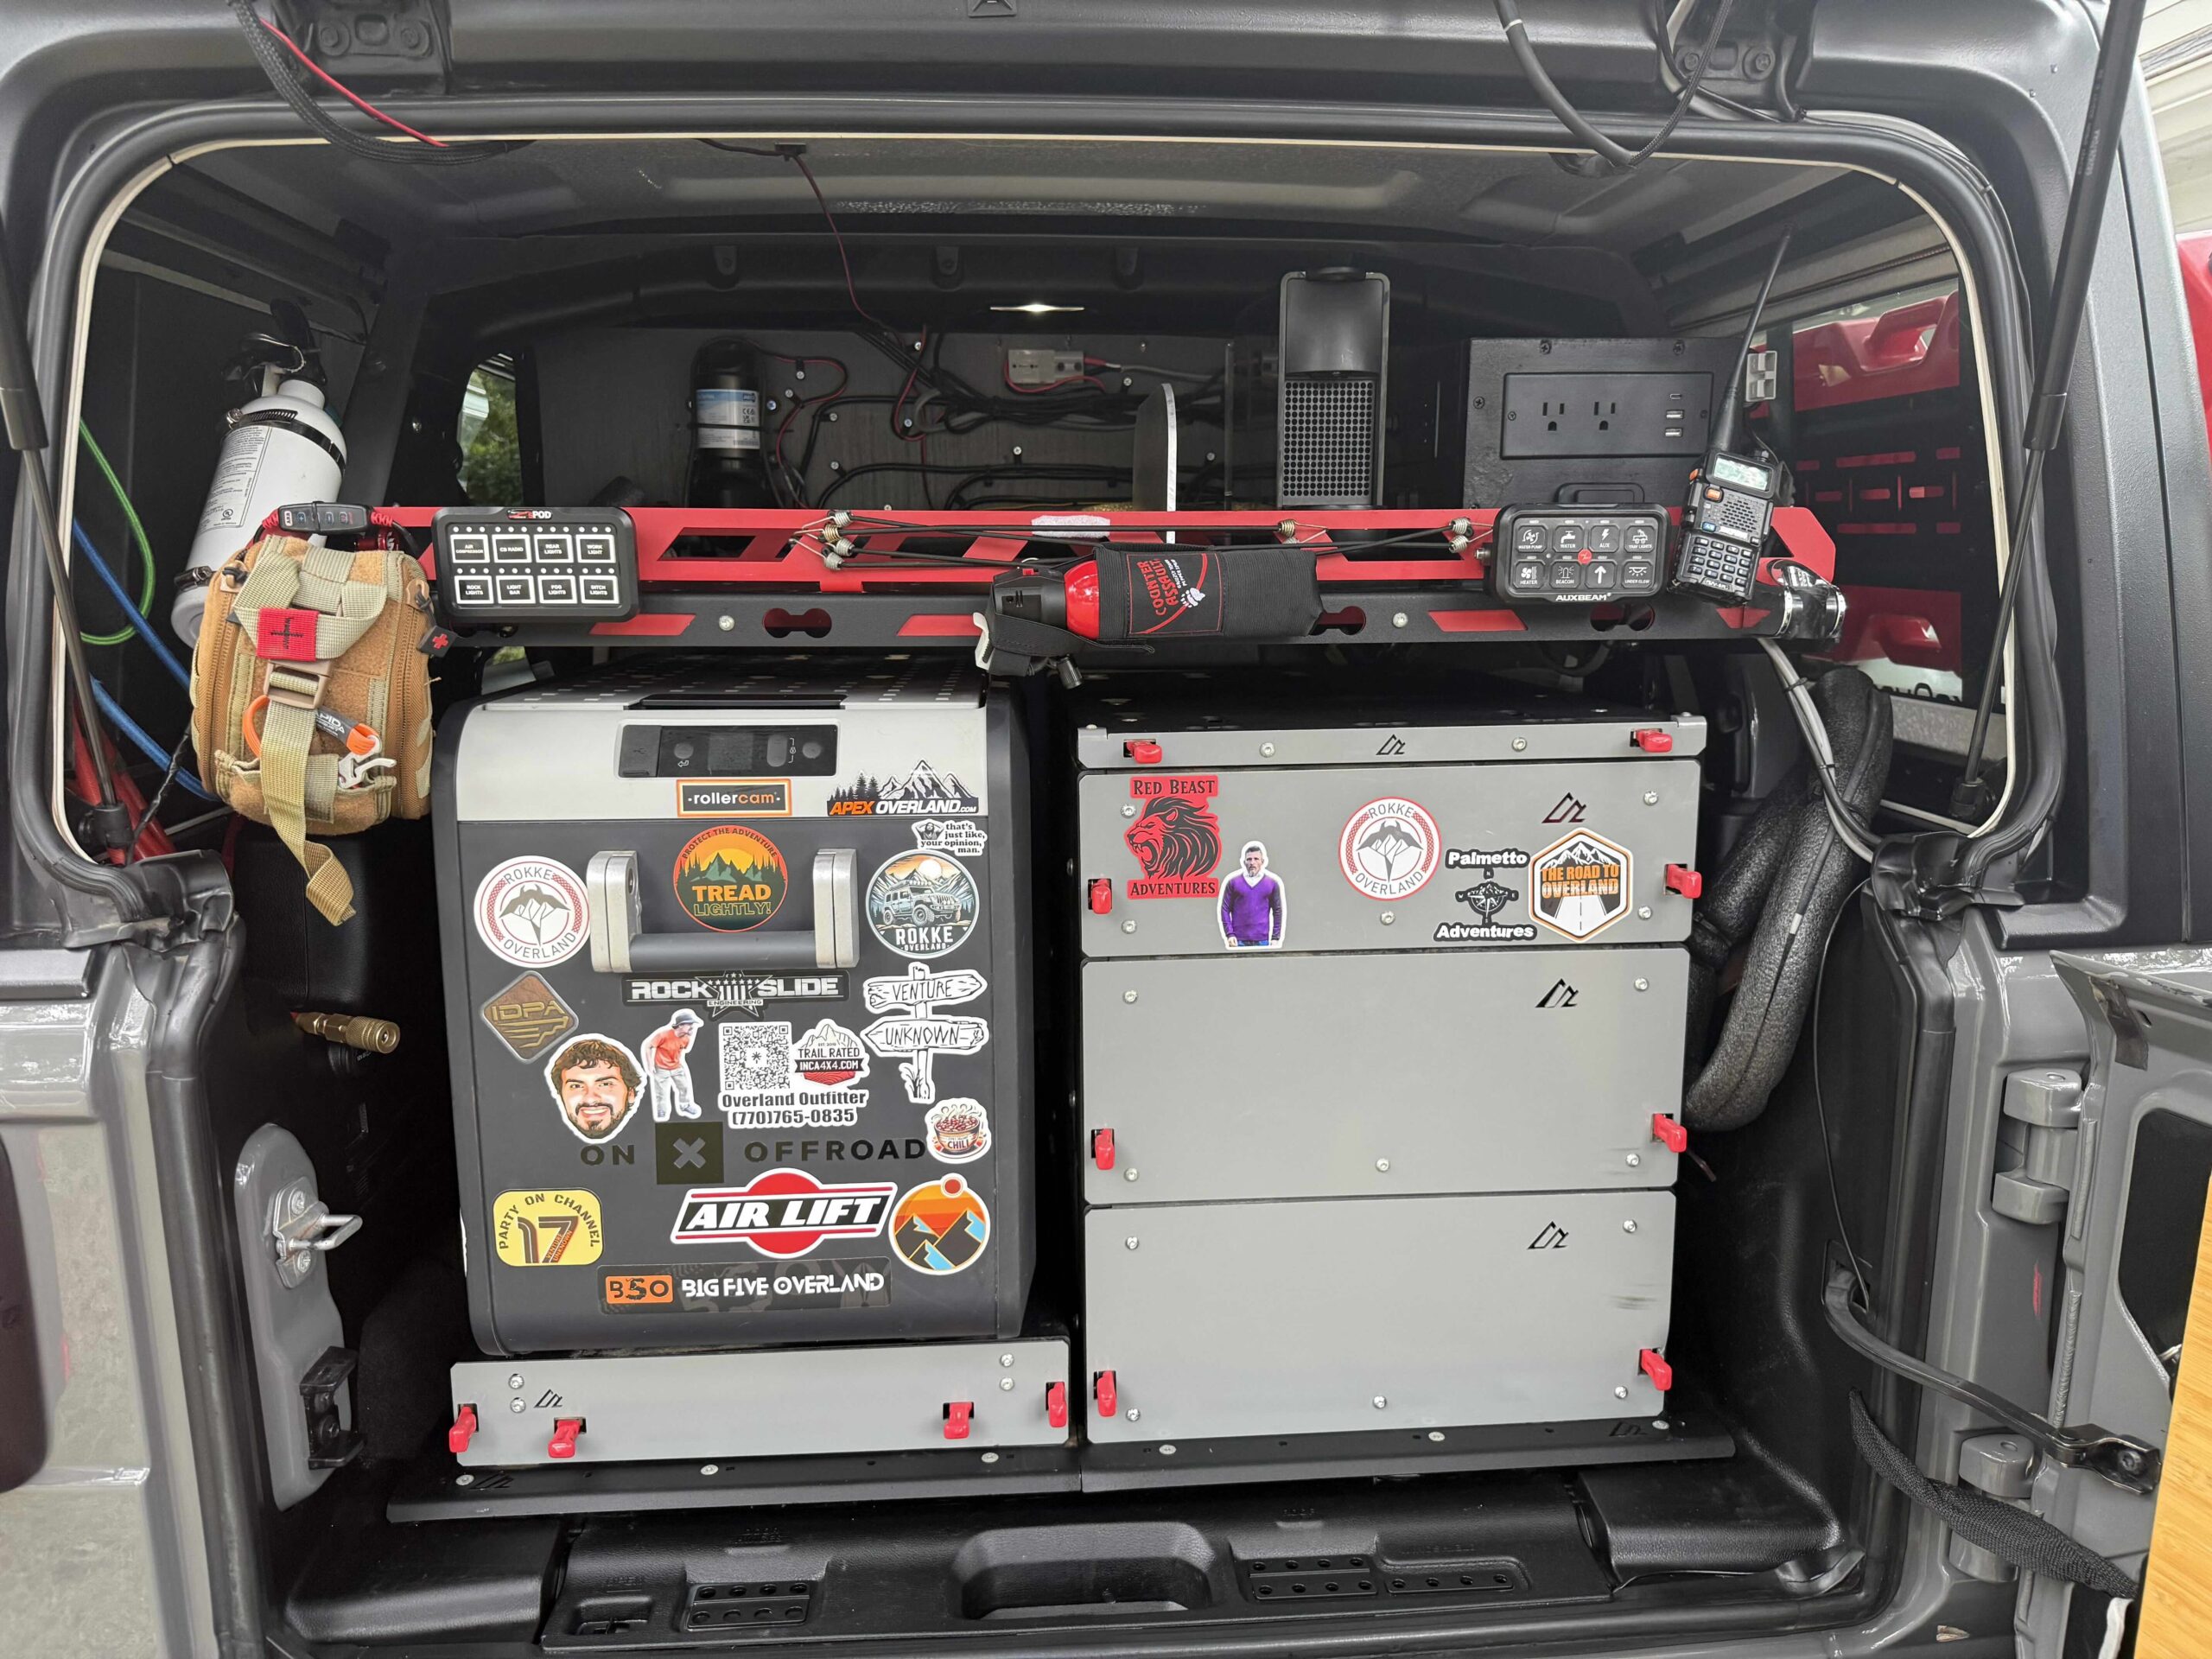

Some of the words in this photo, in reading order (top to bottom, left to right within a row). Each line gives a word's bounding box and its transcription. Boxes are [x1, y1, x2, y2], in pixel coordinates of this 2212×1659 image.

[1136, 560, 1168, 616] COUNTER
[1149, 558, 1179, 606] ASSAULT
[1134, 779, 1163, 795] RED
[1170, 779, 1216, 794] BEAST
[694, 791, 777, 804] rollercam
[830, 800, 875, 816] APEX
[1368, 803, 1414, 819] ROKKE
[683, 832, 715, 859] PROTECT
[713, 827, 730, 836] THE
[732, 828, 778, 858] ADVENTURE
[944, 839, 982, 848] opinion,
[1448, 851, 1528, 865] Palmetto
[503, 867, 554, 884] ROKKE
[1541, 868, 1563, 881] THE
[1567, 865, 1600, 880] ROAD
[1603, 864, 1619, 878] TO
[1130, 882, 1216, 896] ADVENTURES
[1355, 871, 1423, 895] OVERLAND
[1541, 879, 1619, 899] OVERLAND
[691, 884, 772, 902] TREAD
[694, 902, 772, 917] LIGHTLY!
[895, 926, 953, 944] ROKKE
[1436, 925, 1534, 938] Adventures
[503, 932, 576, 959] OVERLAND
[904, 943, 947, 951] OVERLAND
[632, 981, 715, 1000] ROCK
[757, 977, 839, 996] SLIDE
[893, 979, 954, 1001] VENTURE
[492, 1000, 566, 1021] IDPA
[886, 1025, 960, 1046] UNKNOWN
[798, 1048, 828, 1058] TRAIL
[829, 1047, 860, 1058] RATED
[800, 1060, 859, 1071] INCA4X4.COM
[722, 1093, 795, 1108] Overland
[799, 1091, 867, 1105] Outfitter
[733, 1109, 855, 1125] (770)765-0835
[581, 1145, 635, 1166] ON
[744, 1139, 926, 1163] OFFROAD
[499, 1205, 520, 1249] PARTY
[524, 1193, 545, 1206] ON
[555, 1194, 600, 1248] CHANNEL
[685, 1202, 770, 1230] AIR
[781, 1198, 882, 1226] LIFT
[518, 1216, 579, 1263] 17
[546, 1233, 563, 1259] VENTURE
[554, 1230, 573, 1262] UNKNOWN
[682, 1279, 719, 1298] BIG
[723, 1277, 769, 1296] FIVE
[772, 1273, 885, 1295] OVERLAND
